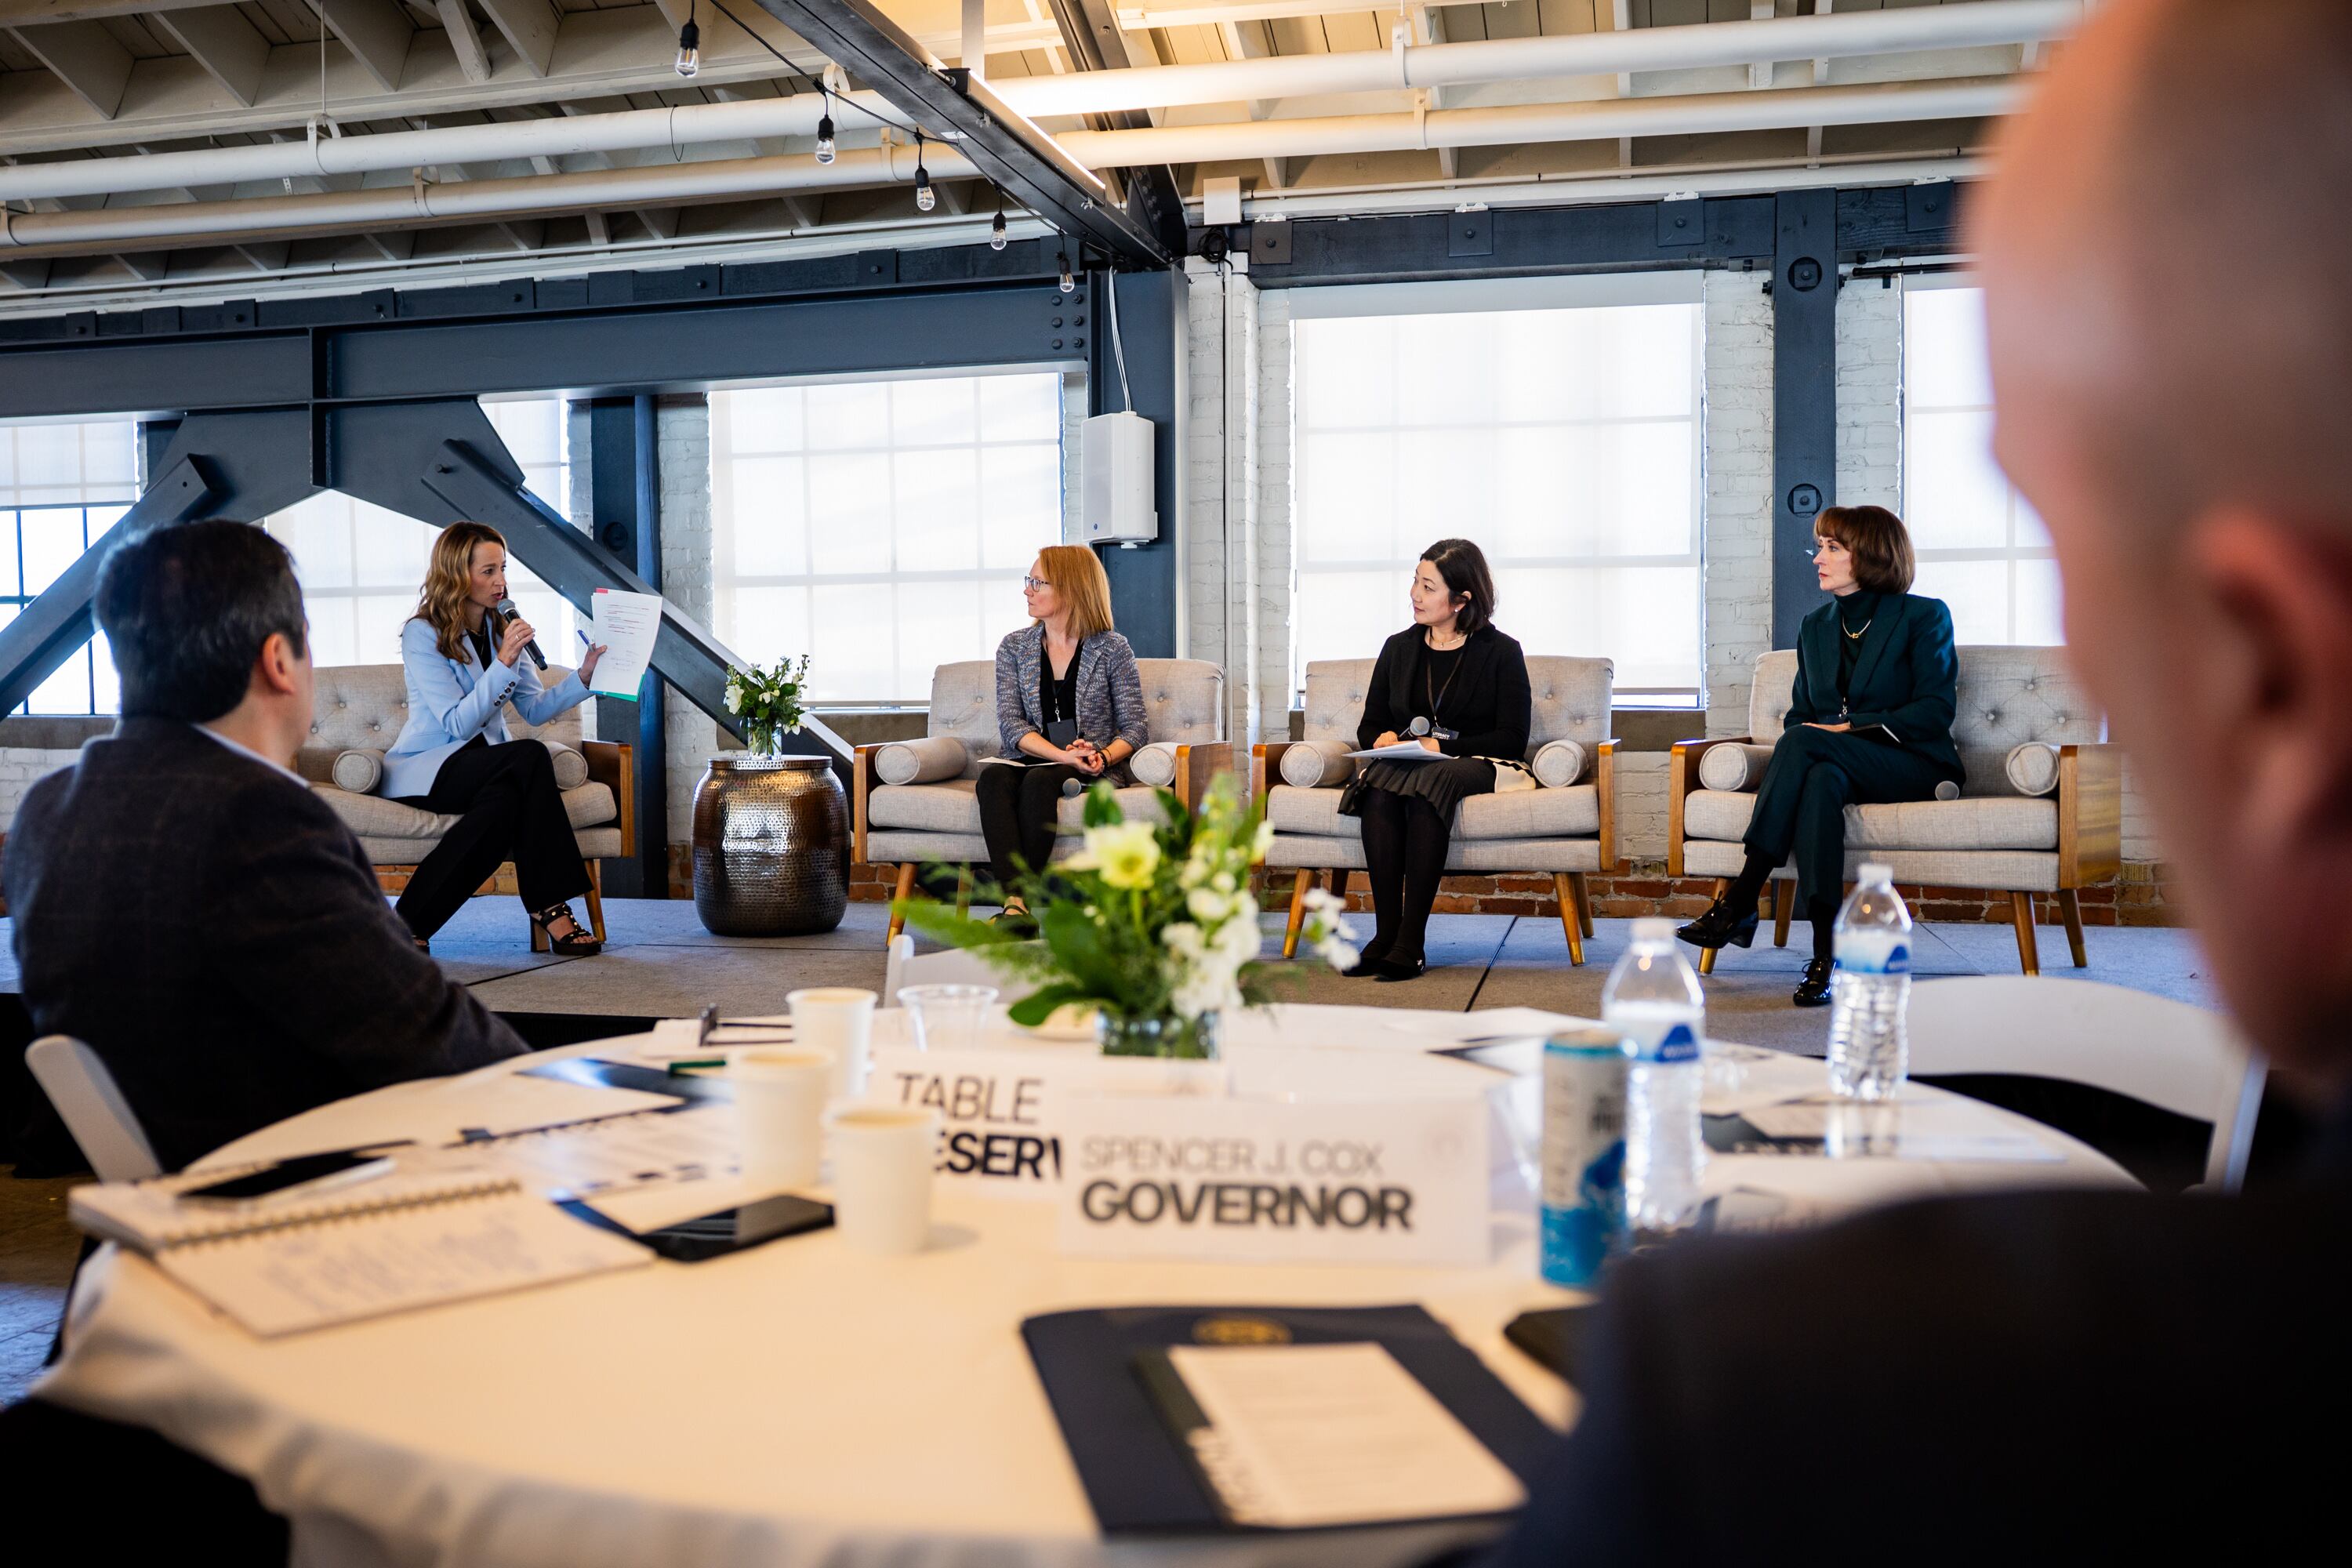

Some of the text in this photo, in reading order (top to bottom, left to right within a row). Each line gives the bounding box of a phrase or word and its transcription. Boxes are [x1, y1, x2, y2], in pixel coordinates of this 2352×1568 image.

[895, 1073, 1044, 1124] TABLE
[1082, 1136, 1255, 1174] SPENCER
[1299, 1139, 1385, 1178] COX
[1081, 1180, 1414, 1230] GOVERNOR
